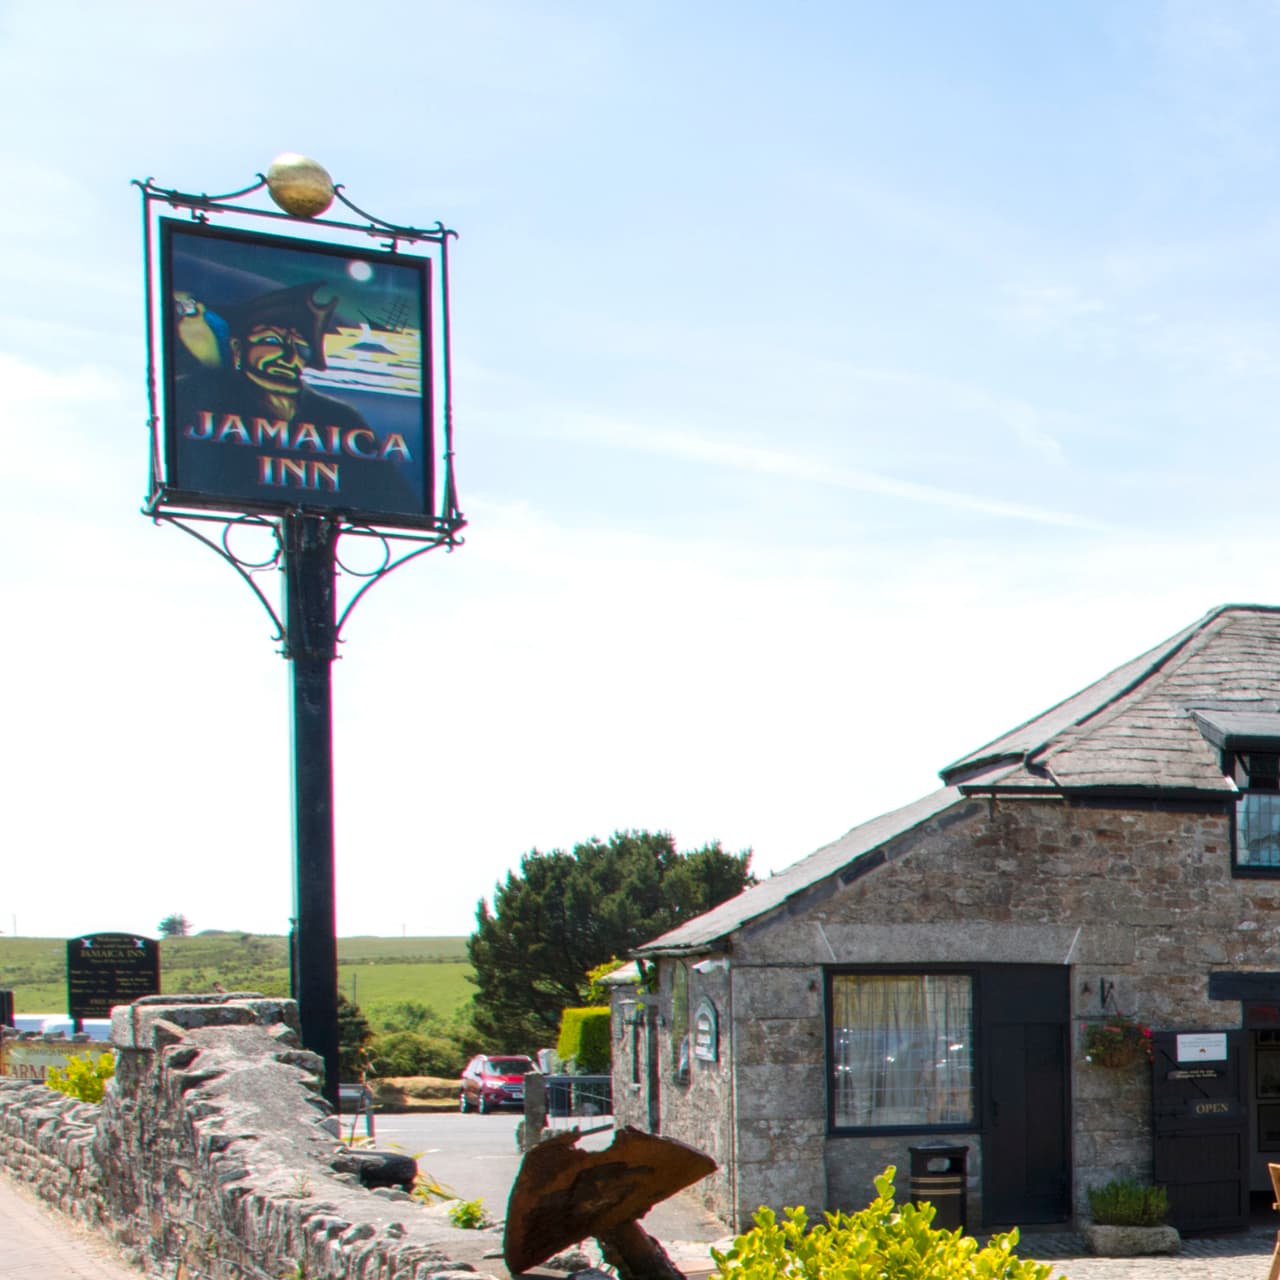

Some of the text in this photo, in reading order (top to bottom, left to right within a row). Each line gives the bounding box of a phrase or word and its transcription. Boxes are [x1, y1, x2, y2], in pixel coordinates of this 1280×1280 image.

[184, 410, 413, 461] JAMAICA
[256, 455, 341, 493] INN
[80, 949, 124, 958] JAMAICA
[1196, 1103, 1229, 1113] OPEN
